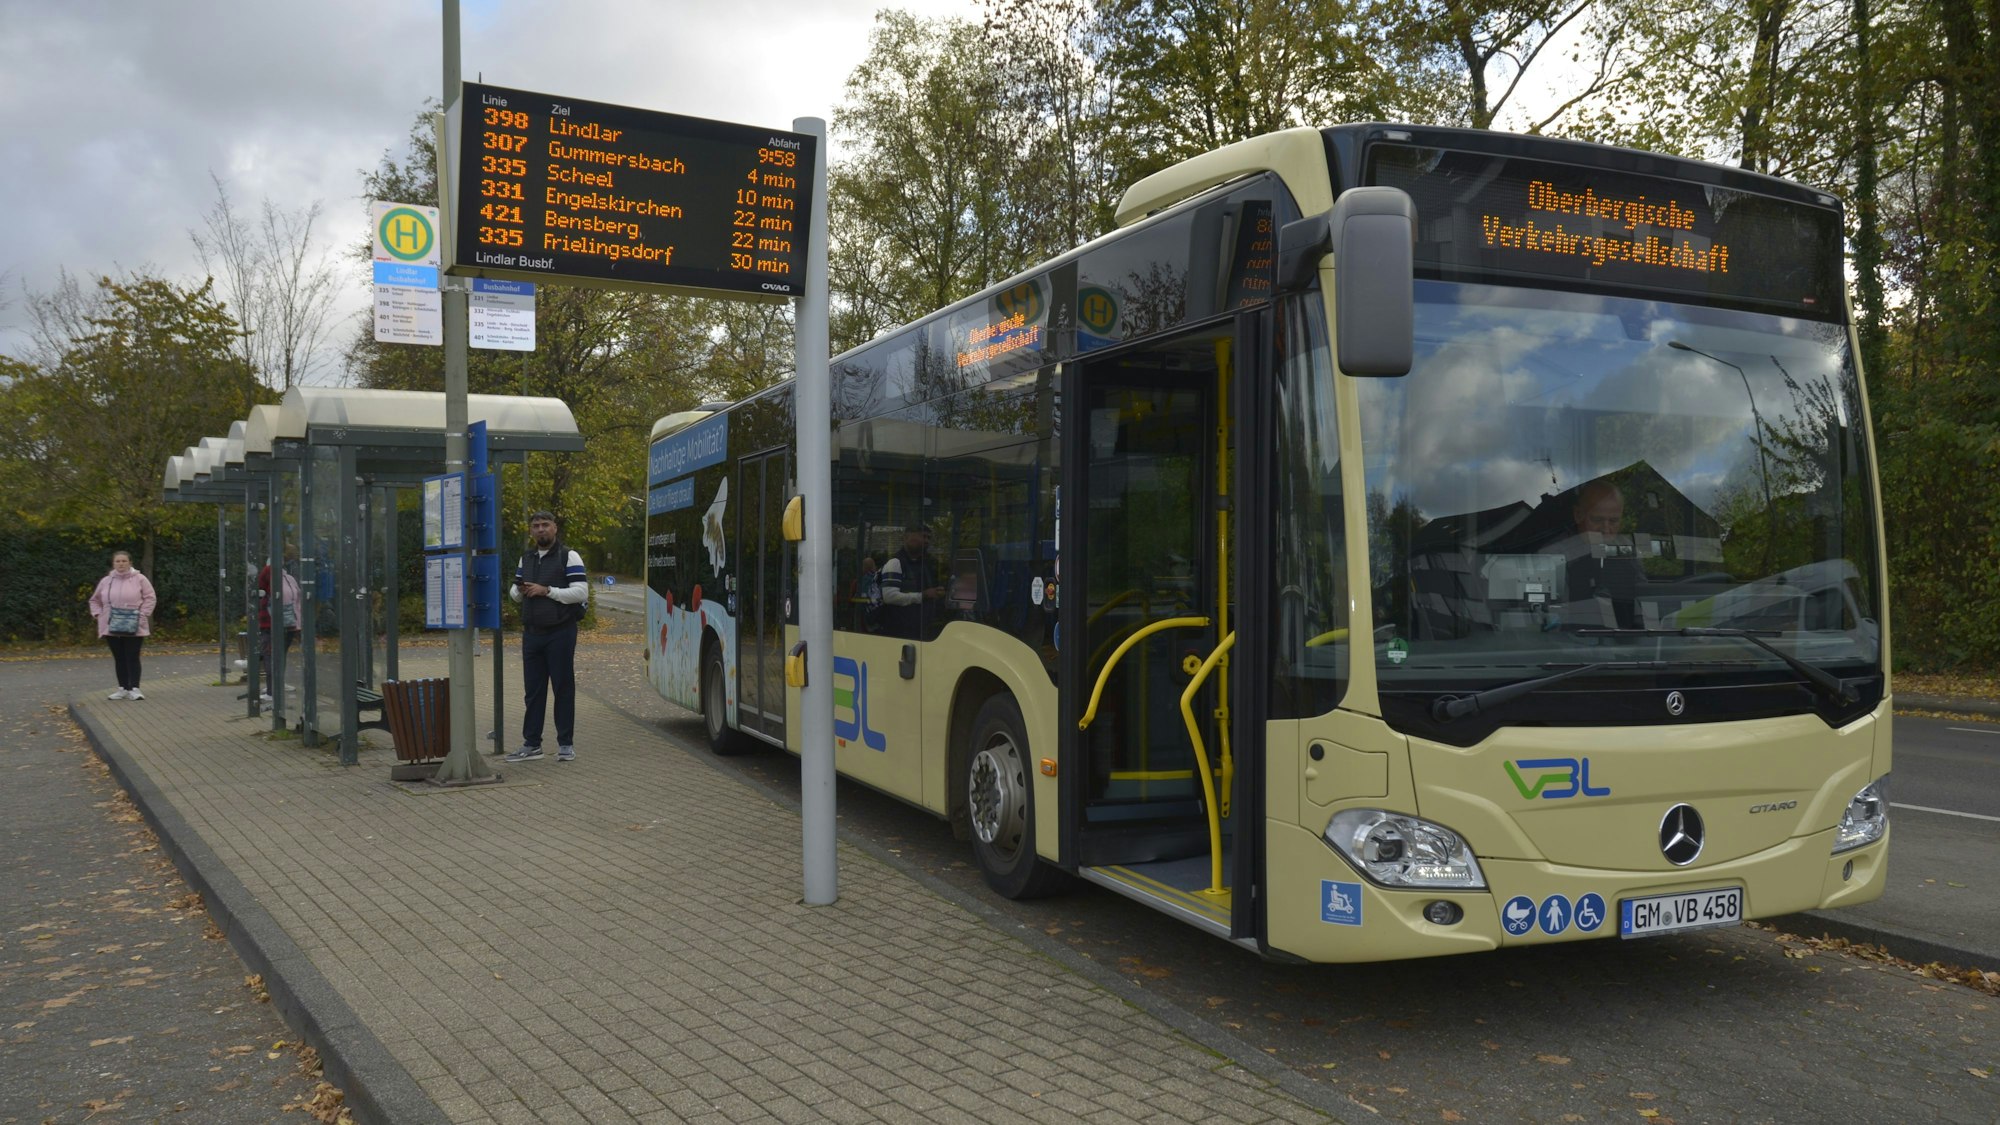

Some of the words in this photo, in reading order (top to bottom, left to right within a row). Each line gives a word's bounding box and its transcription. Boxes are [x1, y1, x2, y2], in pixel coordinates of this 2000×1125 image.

[482, 94, 508, 107] Linie
[551, 104, 571, 116] Ziel
[484, 107, 529, 129] 398
[550, 117, 623, 142] Lindlar
[758, 148, 796, 167] 9:58
[768, 137, 800, 150] Abfahrt
[483, 131, 528, 153] 307
[548, 141, 686, 174] Gummersbach
[747, 168, 758, 184] 4
[763, 172, 796, 189] min
[482, 156, 527, 177] 335
[547, 163, 614, 188] Scheel
[736, 189, 757, 206] 10
[762, 194, 794, 211] min
[481, 178, 525, 200] 331
[545, 186, 683, 219] Engelskirchen
[733, 210, 756, 227] 22
[760, 215, 792, 232] min
[1529, 180, 1695, 231] Oberbergische
[395, 218, 418, 250] H
[480, 203, 524, 224] 421
[545, 210, 640, 240] Bensberg
[731, 231, 754, 249] 22
[758, 236, 791, 253] min
[1483, 215, 1729, 273] Verkehrsgesellschaft
[475, 252, 516, 266] Lindlar
[519, 255, 556, 270] Busbf.
[479, 226, 524, 247] 335
[543, 233, 674, 266] Frielingsdorf
[730, 253, 753, 271] 30
[757, 257, 790, 274] min
[483, 284, 521, 292] Busbahnhof
[761, 282, 790, 292] OVAG
[687, 424, 724, 462] Mobilität?
[833, 655, 886, 752] BL
[1503, 757, 1611, 800] VBL
[1624, 920, 1630, 929] D
[1634, 901, 1661, 929] GM
[1674, 898, 1698, 924] VB
[1703, 893, 1738, 920] 458
